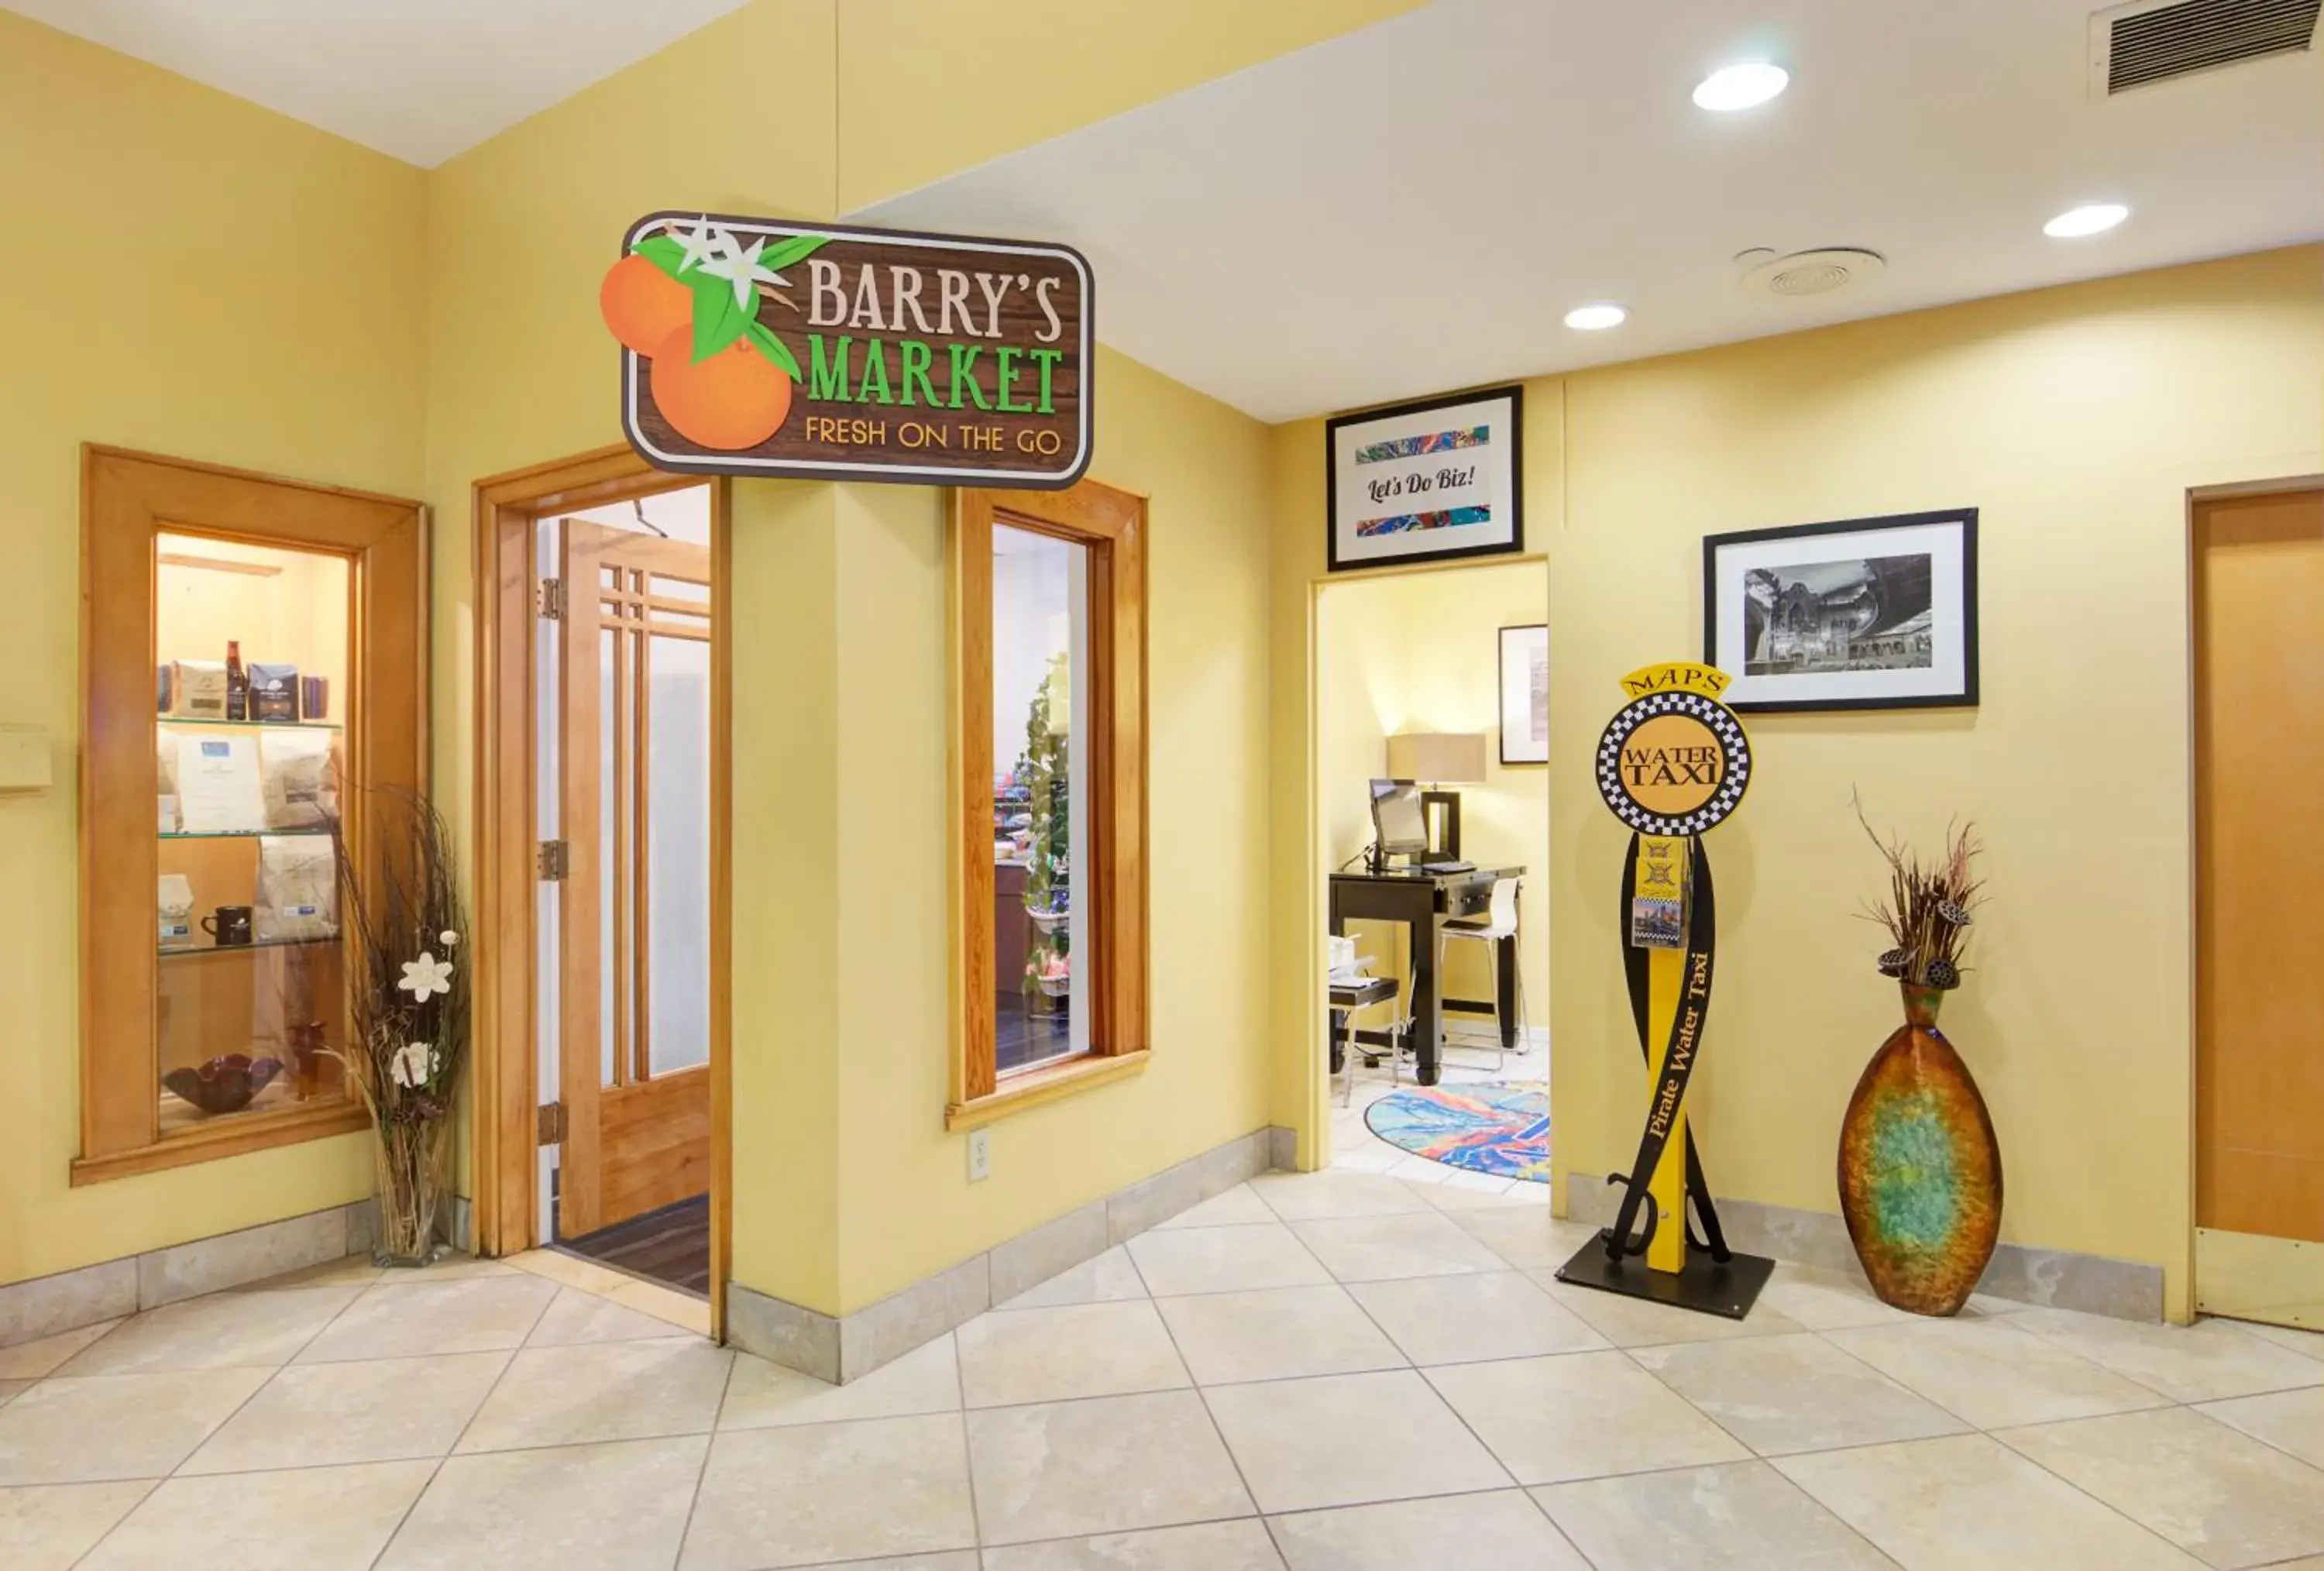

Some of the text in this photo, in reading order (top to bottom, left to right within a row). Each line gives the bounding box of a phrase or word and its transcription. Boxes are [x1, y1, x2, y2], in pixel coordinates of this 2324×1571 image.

[806, 259, 1063, 342] BARRY'S
[807, 334, 1062, 413] MARKET
[806, 417, 1061, 455] FRESH ON THE GO
[1367, 466, 1476, 504] Let's Do Biz!
[1624, 669, 1724, 695] MAPS
[1625, 747, 1718, 764] WATER
[1624, 764, 1721, 786] TAXI
[1649, 952, 1708, 1139] Pirate Water Taxi
